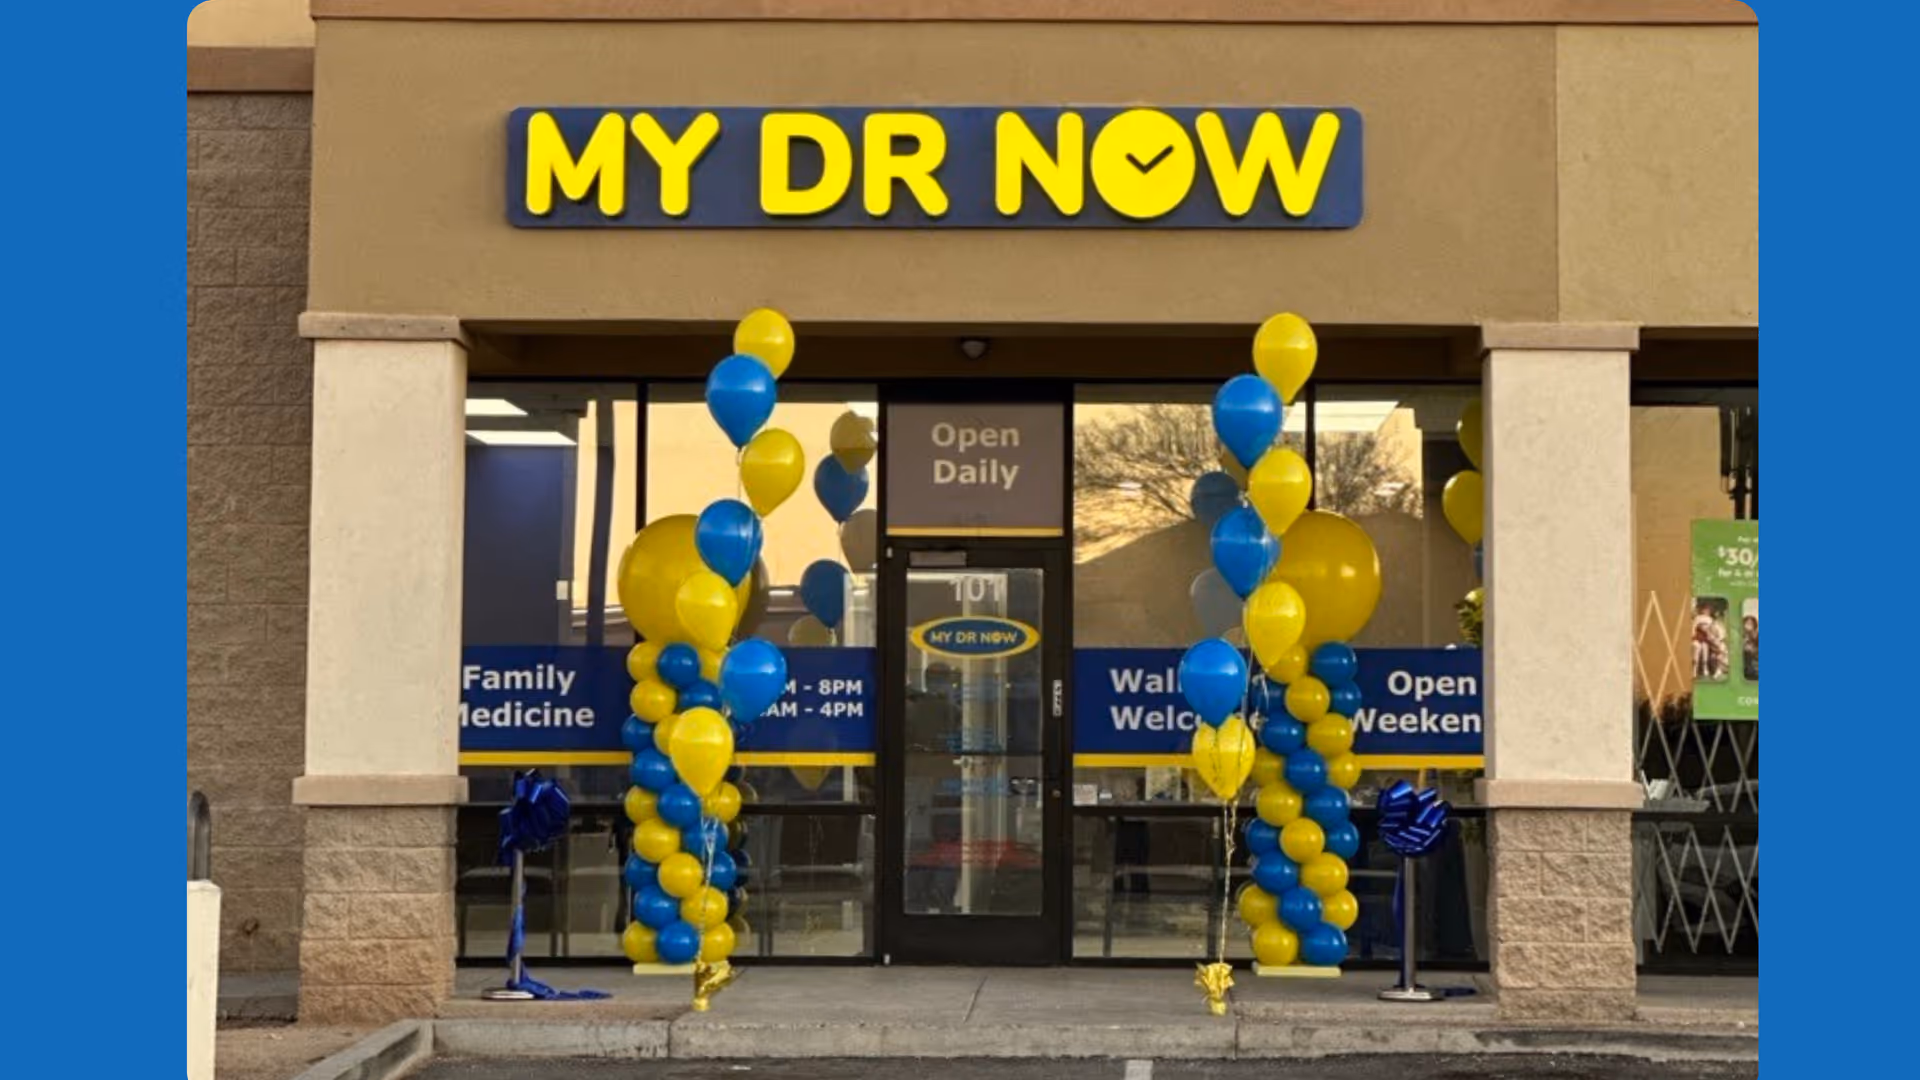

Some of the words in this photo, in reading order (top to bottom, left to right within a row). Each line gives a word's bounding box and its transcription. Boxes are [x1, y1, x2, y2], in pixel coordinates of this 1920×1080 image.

[526, 111, 719, 216] MY
[760, 112, 949, 216] DR
[995, 108, 1340, 219] NOW
[931, 422, 1020, 453] Open
[933, 458, 1020, 490] Daily
[1718, 545, 1758, 569] $30/
[949, 576, 1000, 602] 101
[930, 630, 953, 643] MY
[955, 631, 977, 644] DR
[979, 631, 1018, 645] NOW
[463, 664, 576, 697] Family
[818, 679, 863, 696] 8PM
[1387, 670, 1477, 702] Open
[760, 702, 798, 717] AM
[820, 702, 863, 718] 4PM
[1353, 707, 1482, 734] Weeken
